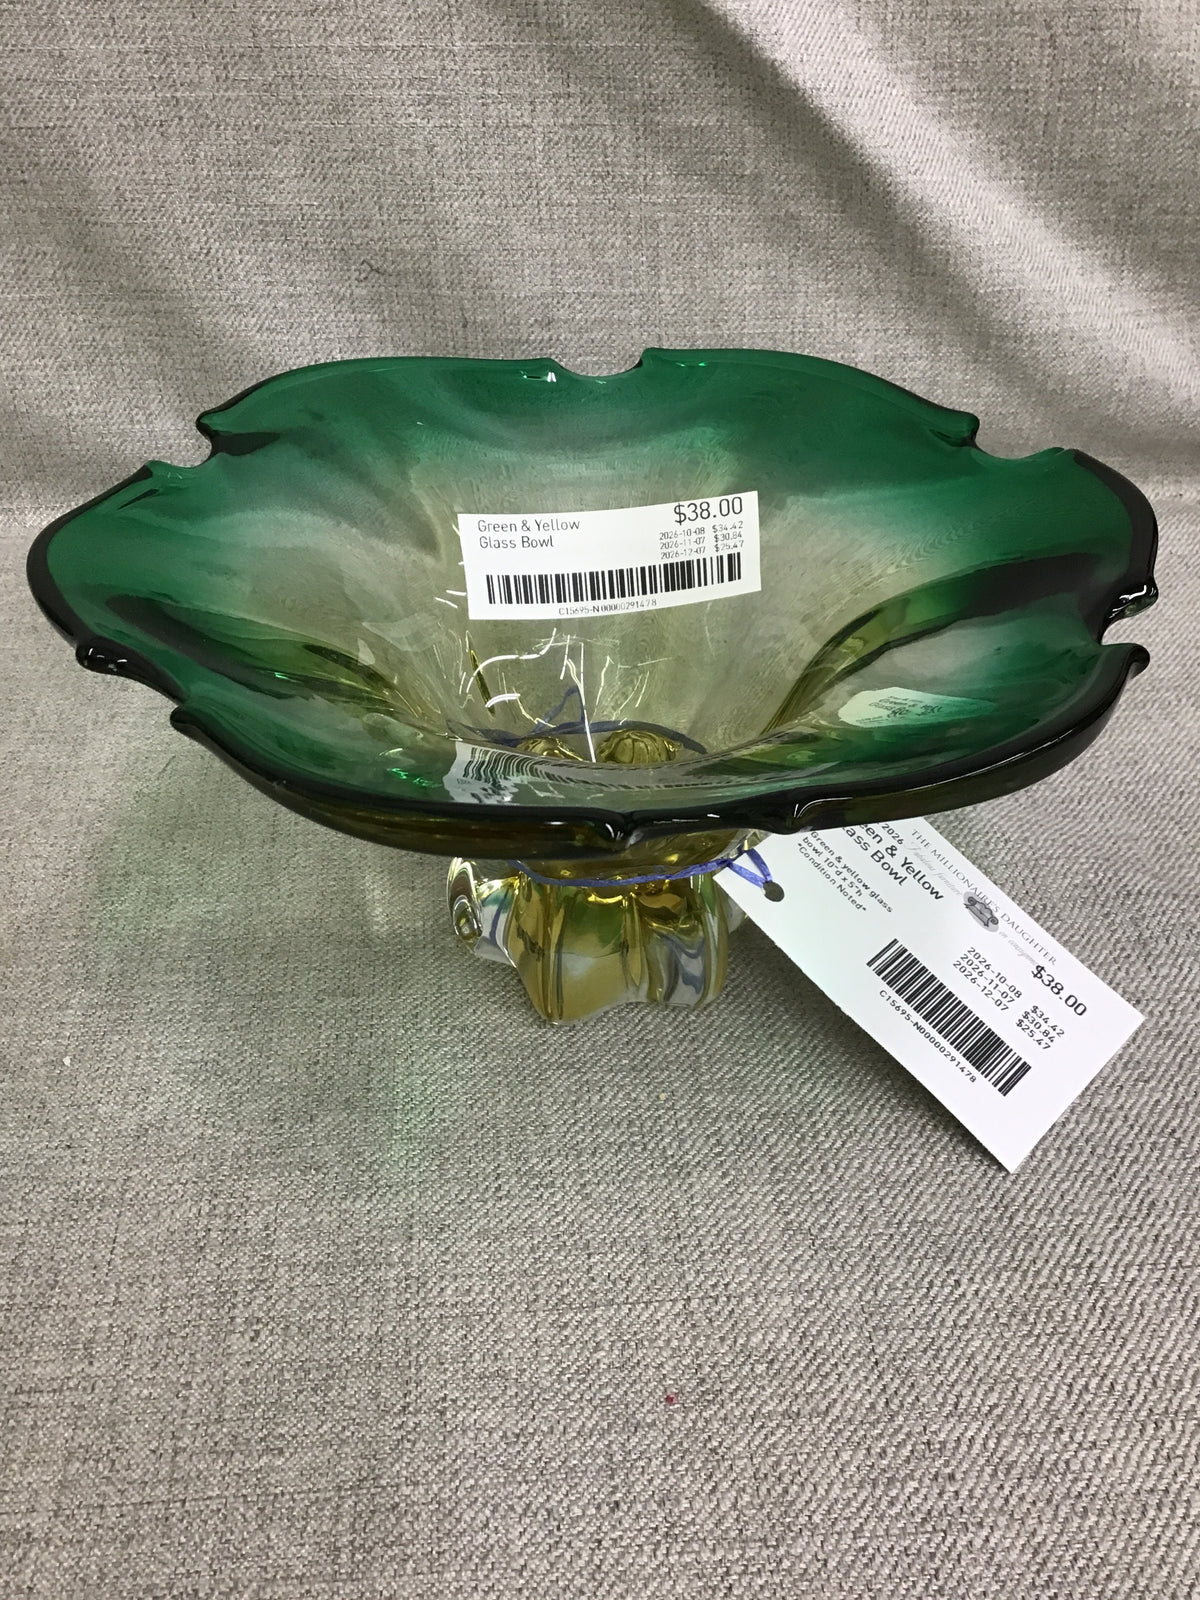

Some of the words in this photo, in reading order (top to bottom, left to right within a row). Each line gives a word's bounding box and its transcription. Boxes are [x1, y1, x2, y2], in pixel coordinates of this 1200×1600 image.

[477, 519, 517, 533] Green
[521, 519, 531, 532] &
[535, 518, 580, 532] Yellow
[659, 526, 706, 541] 2026-10-08
[711, 520, 744, 534] $34.42
[673, 496, 743, 526] $38.00
[479, 535, 517, 549] Glass
[521, 535, 554, 549] Bowl
[659, 536, 706, 550] 2026-11-07
[713, 530, 743, 543] $30.84
[660, 546, 706, 560] 2026-12-07
[714, 540, 744, 553] $25.47
[802, 836, 824, 857] bowl
[841, 827, 871, 852] ass
[870, 850, 908, 887] Bowl
[881, 822, 905, 845] 2026
[810, 831, 835, 857] Green
[835, 855, 843, 863] &
[841, 863, 871, 891] yellow
[868, 890, 893, 913] glass
[859, 824, 884, 844] een
[885, 845, 898, 859] &
[900, 857, 945, 901] Yellow
[911, 829, 931, 848] THE
[931, 849, 1001, 913] MILLIONAIRE'S
[1000, 913, 1058, 966] DAUGHTER
[953, 960, 1009, 1012] 2026-12-07
[1015, 1018, 1051, 1050] $25.47
[960, 953, 1016, 1005] 2026-11-07
[1022, 1010, 1057, 1044] $30.84
[967, 946, 1023, 999] 2026-10-08
[1030, 1004, 1065, 1038] $34.42
[1030, 964, 1088, 1017] $38.00
[879, 989, 977, 1083] C15695-N00000291478
